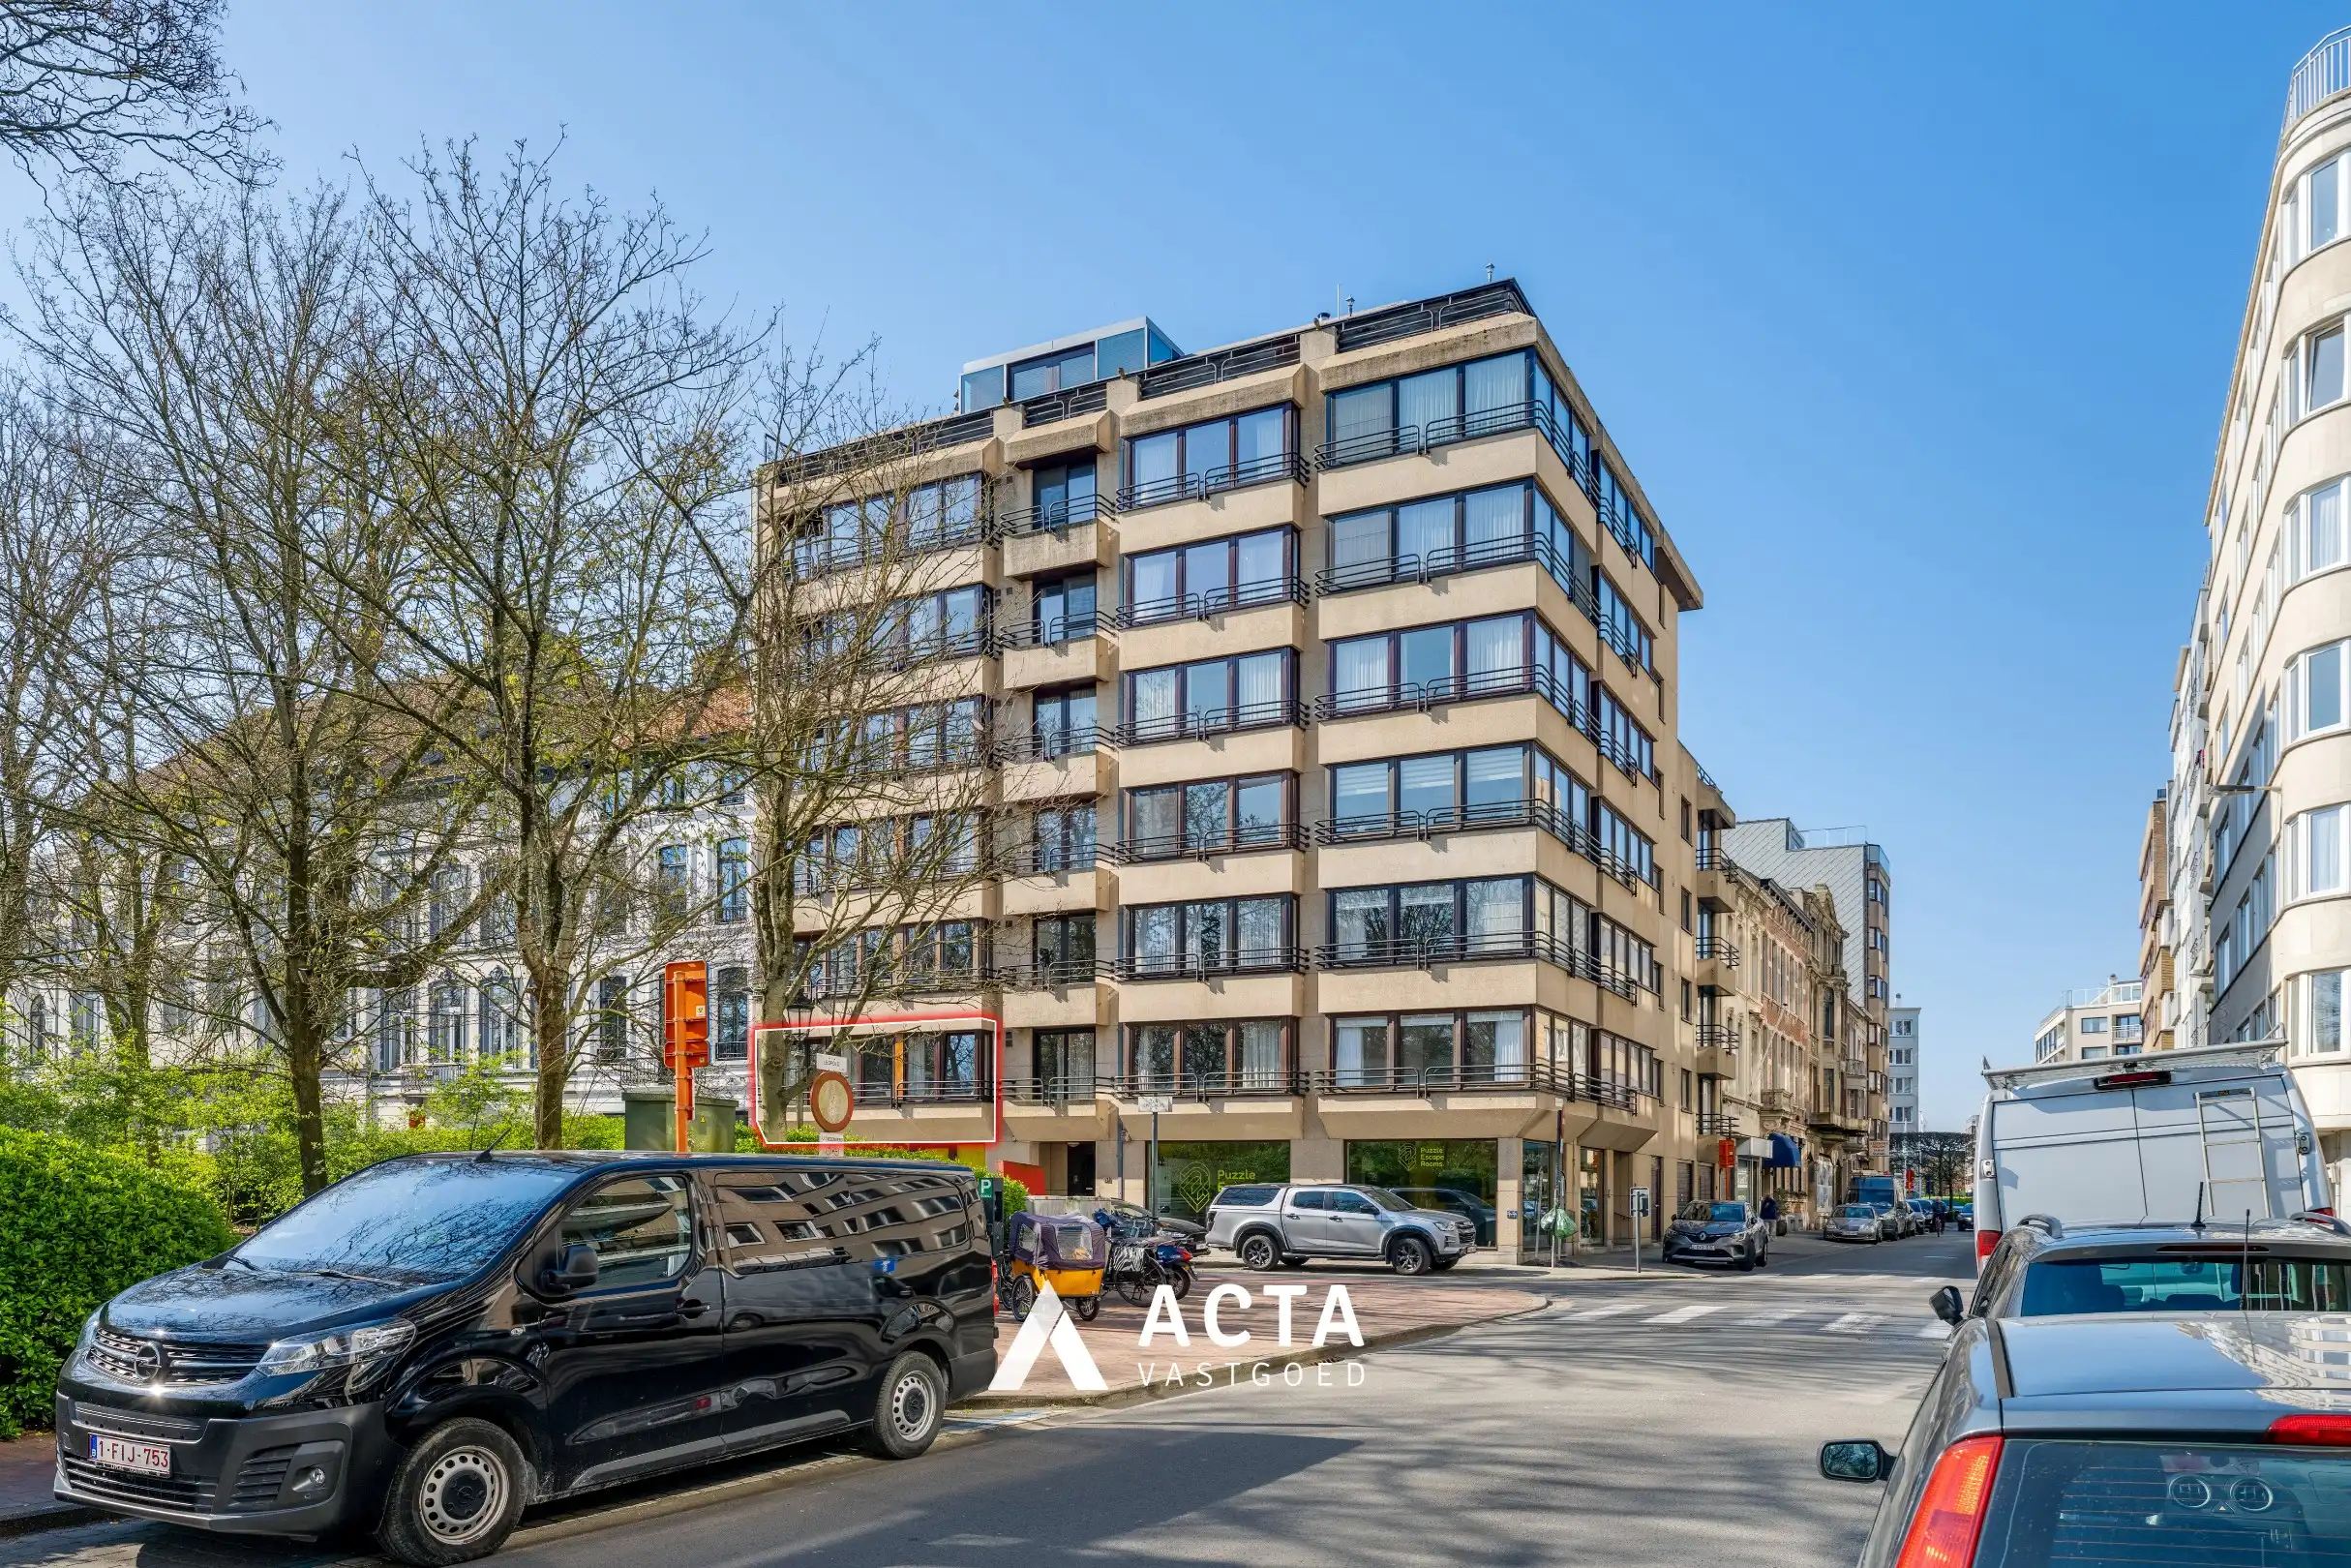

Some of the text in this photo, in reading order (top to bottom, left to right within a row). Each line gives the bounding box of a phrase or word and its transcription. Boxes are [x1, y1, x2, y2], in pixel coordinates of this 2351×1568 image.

[1217, 1169, 1256, 1180] Puzzle
[980, 1179, 992, 1194] P
[99, 1440, 168, 1468] 1-FIJ-753
